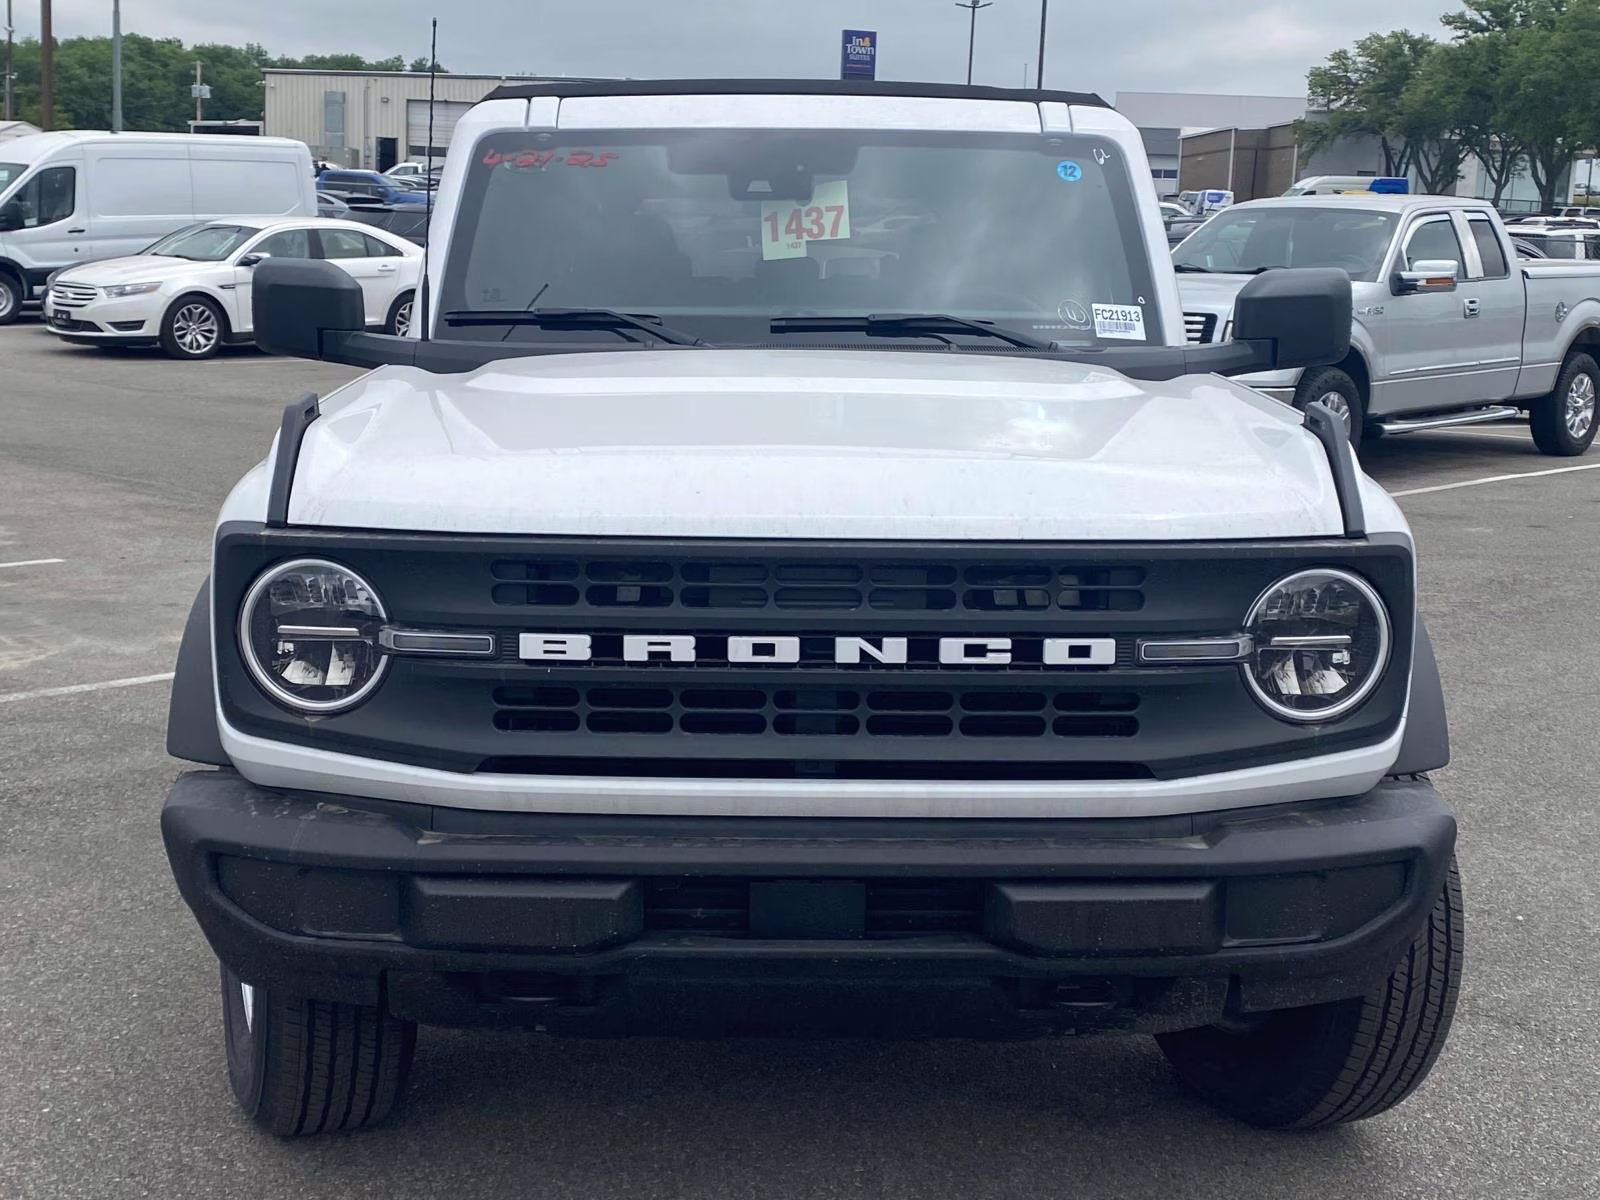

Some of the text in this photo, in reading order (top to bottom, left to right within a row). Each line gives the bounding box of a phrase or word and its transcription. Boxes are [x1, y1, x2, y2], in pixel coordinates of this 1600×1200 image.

[1061, 164, 1078, 178] 12
[764, 205, 845, 243] 1437
[1094, 308, 1141, 322] FC21913
[519, 632, 1116, 665] BRONCO
